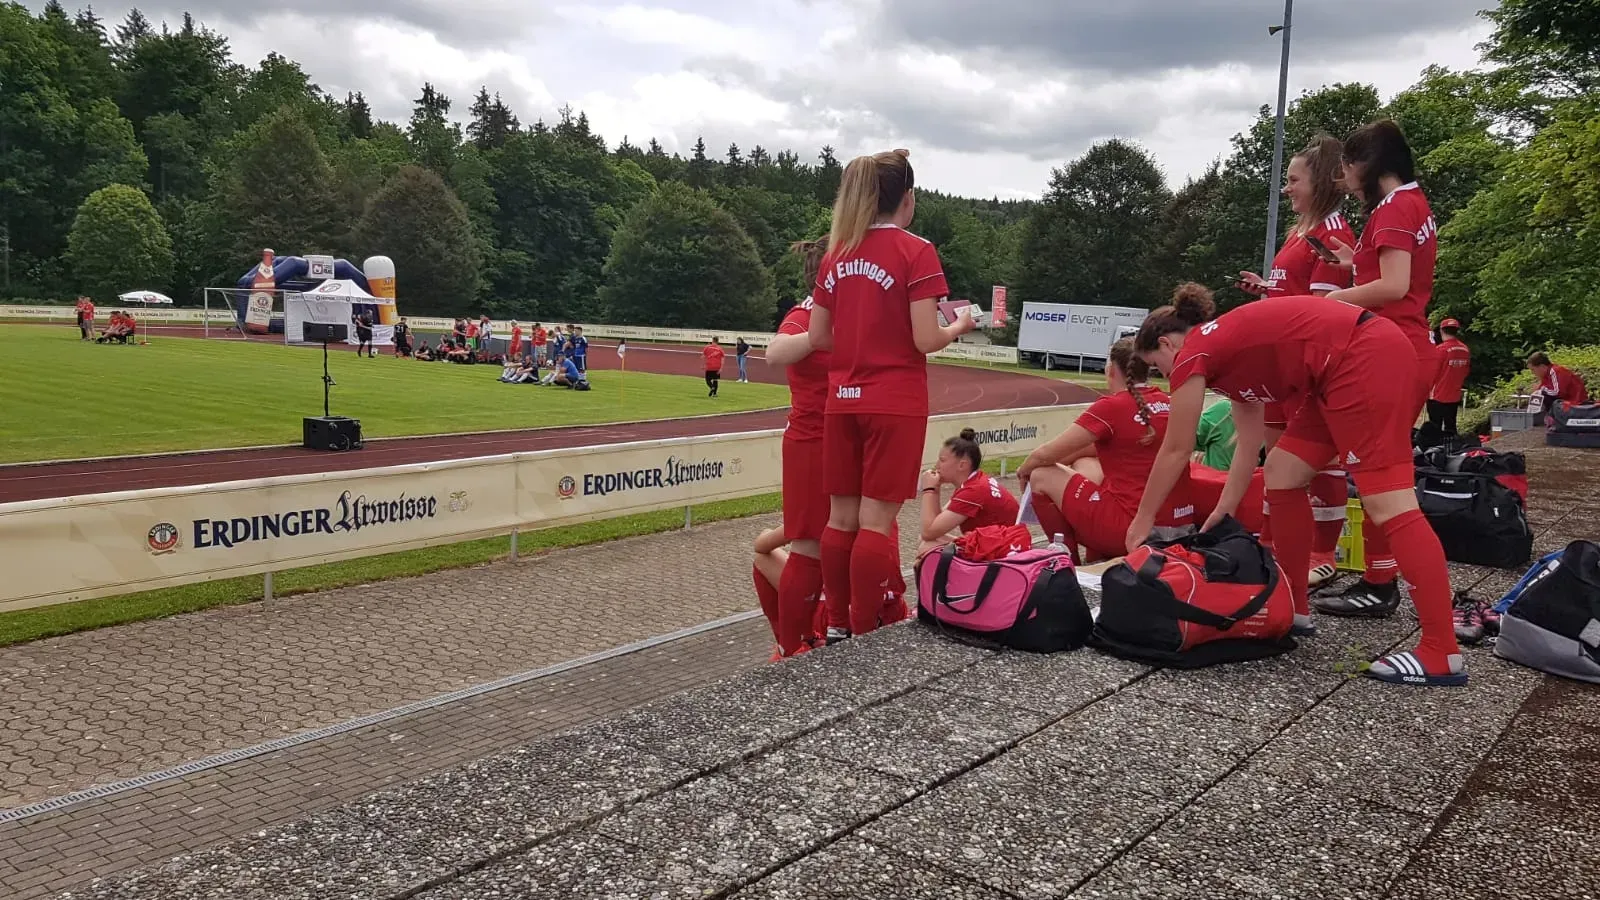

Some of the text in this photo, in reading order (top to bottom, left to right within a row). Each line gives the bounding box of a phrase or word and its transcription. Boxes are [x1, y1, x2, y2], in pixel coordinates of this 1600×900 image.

[823, 258, 895, 293] SV Eutingen
[1025, 310, 1110, 326] MOSER EVENT
[395, 325, 404, 333] 21
[836, 385, 862, 399] Jana
[973, 429, 1009, 445] RDINGER
[583, 468, 664, 496] ERDINGER
[664, 455, 724, 487] Urweisse
[192, 490, 438, 549] ERDINGER Urweisse
